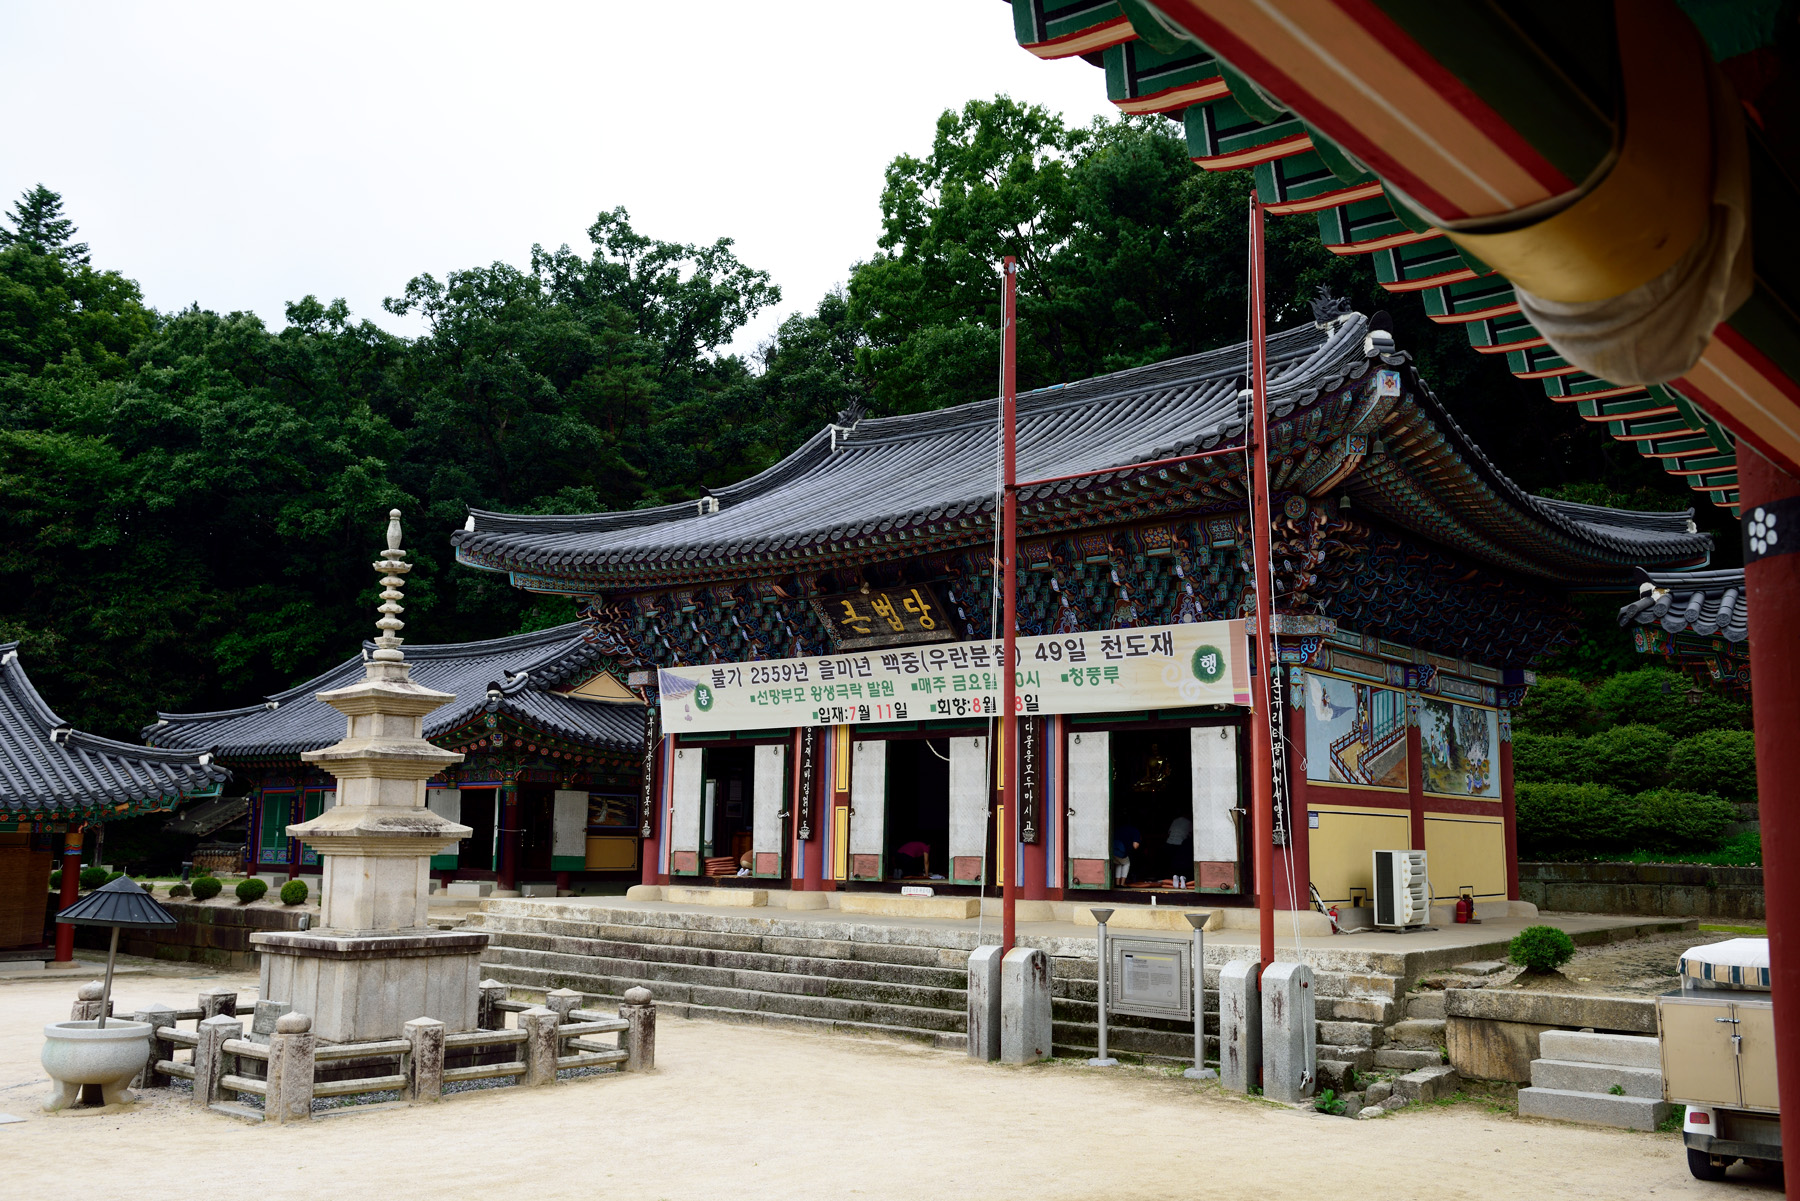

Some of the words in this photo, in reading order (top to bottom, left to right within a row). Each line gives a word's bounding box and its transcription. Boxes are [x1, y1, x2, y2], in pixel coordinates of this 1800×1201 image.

[840, 588, 936, 634] 큰법당
[711, 667, 742, 689] 불기
[751, 661, 810, 684] 2559년
[818, 656, 872, 681] 을미년
[1035, 637, 1087, 662] 49일
[1100, 630, 1175, 659] 천도재
[1199, 653, 1217, 675] 행
[698, 689, 710, 706] 봉
[756, 687, 806, 706] 선망부모
[810, 683, 863, 703] 왕생극락
[867, 680, 895, 698] 발원
[918, 677, 946, 694] 매주
[952, 672, 998, 692] 금요일
[1015, 670, 1041, 688] 0시
[1069, 666, 1120, 687] 청풍루
[877, 702, 908, 720] 11일
[1015, 694, 1040, 712] 8일
[1023, 715, 1035, 831] 다물을모두마시고
